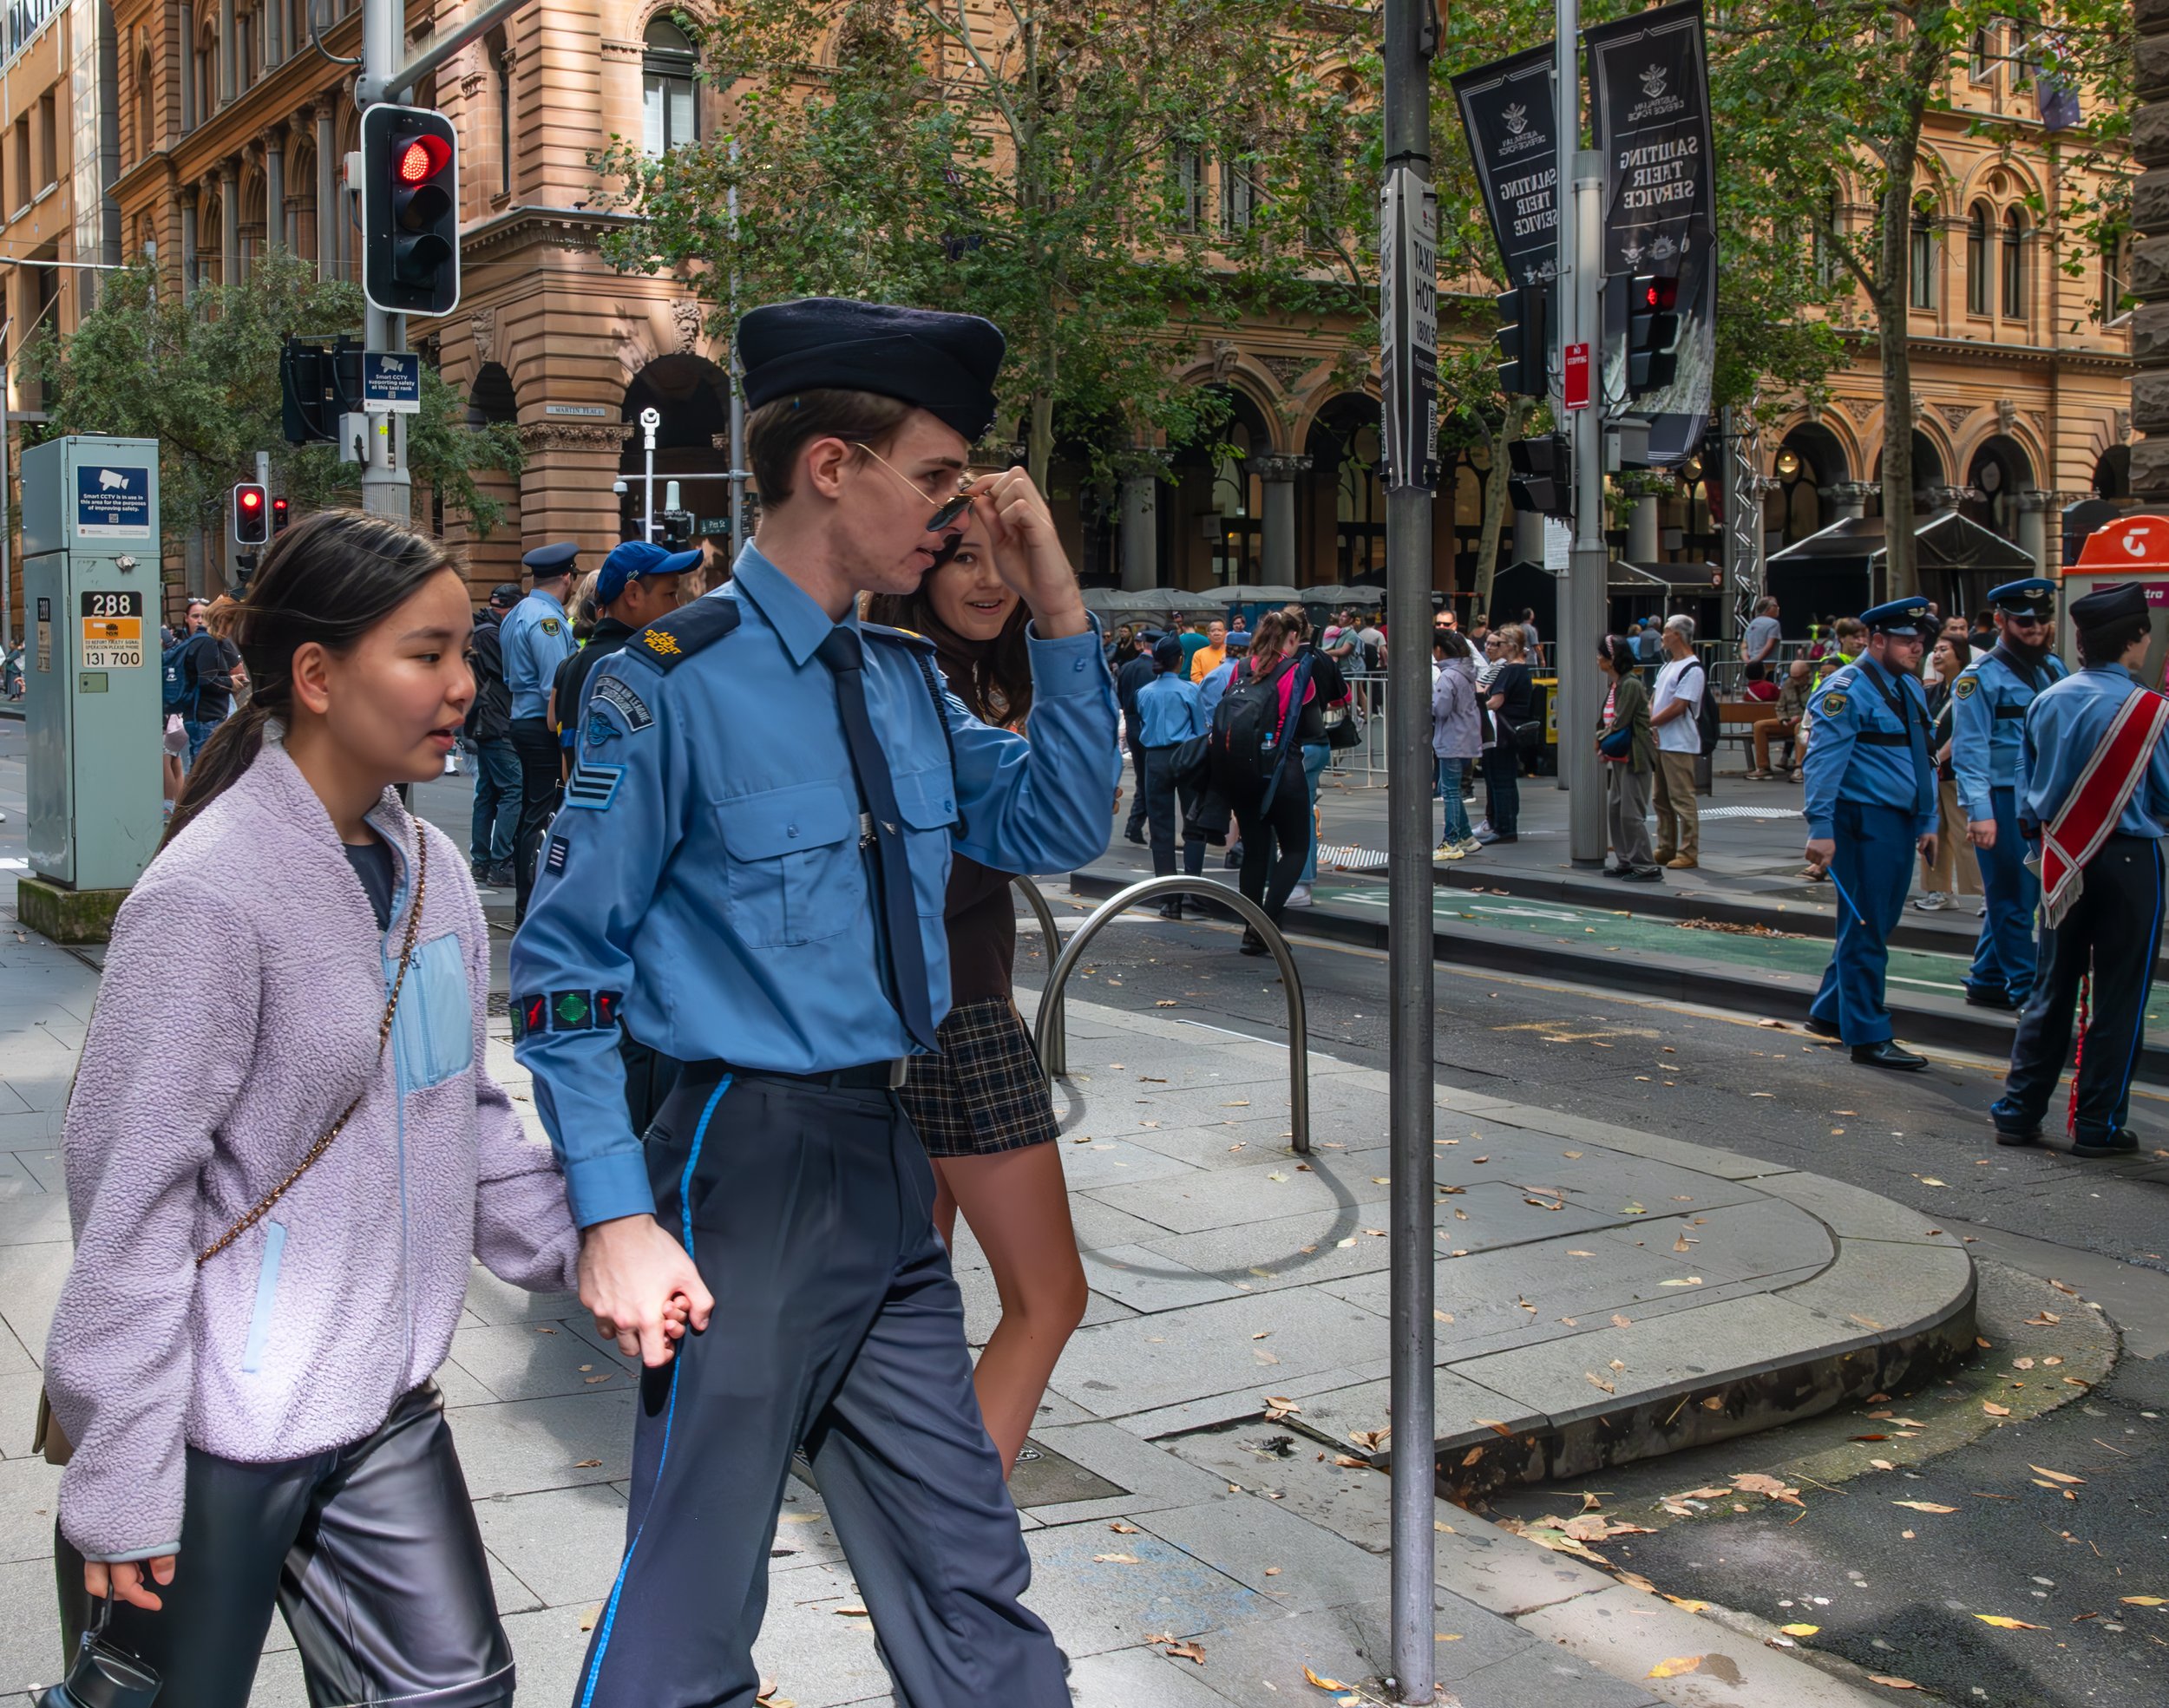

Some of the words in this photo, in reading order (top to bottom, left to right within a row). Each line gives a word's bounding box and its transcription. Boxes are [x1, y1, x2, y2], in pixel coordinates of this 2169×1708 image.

[1413, 239, 1432, 277] TAXI
[1416, 319, 1431, 345] 1800
[93, 595, 130, 614] 288
[643, 638, 671, 655] PILOT
[86, 652, 104, 665] 131
[111, 652, 140, 665] 700
